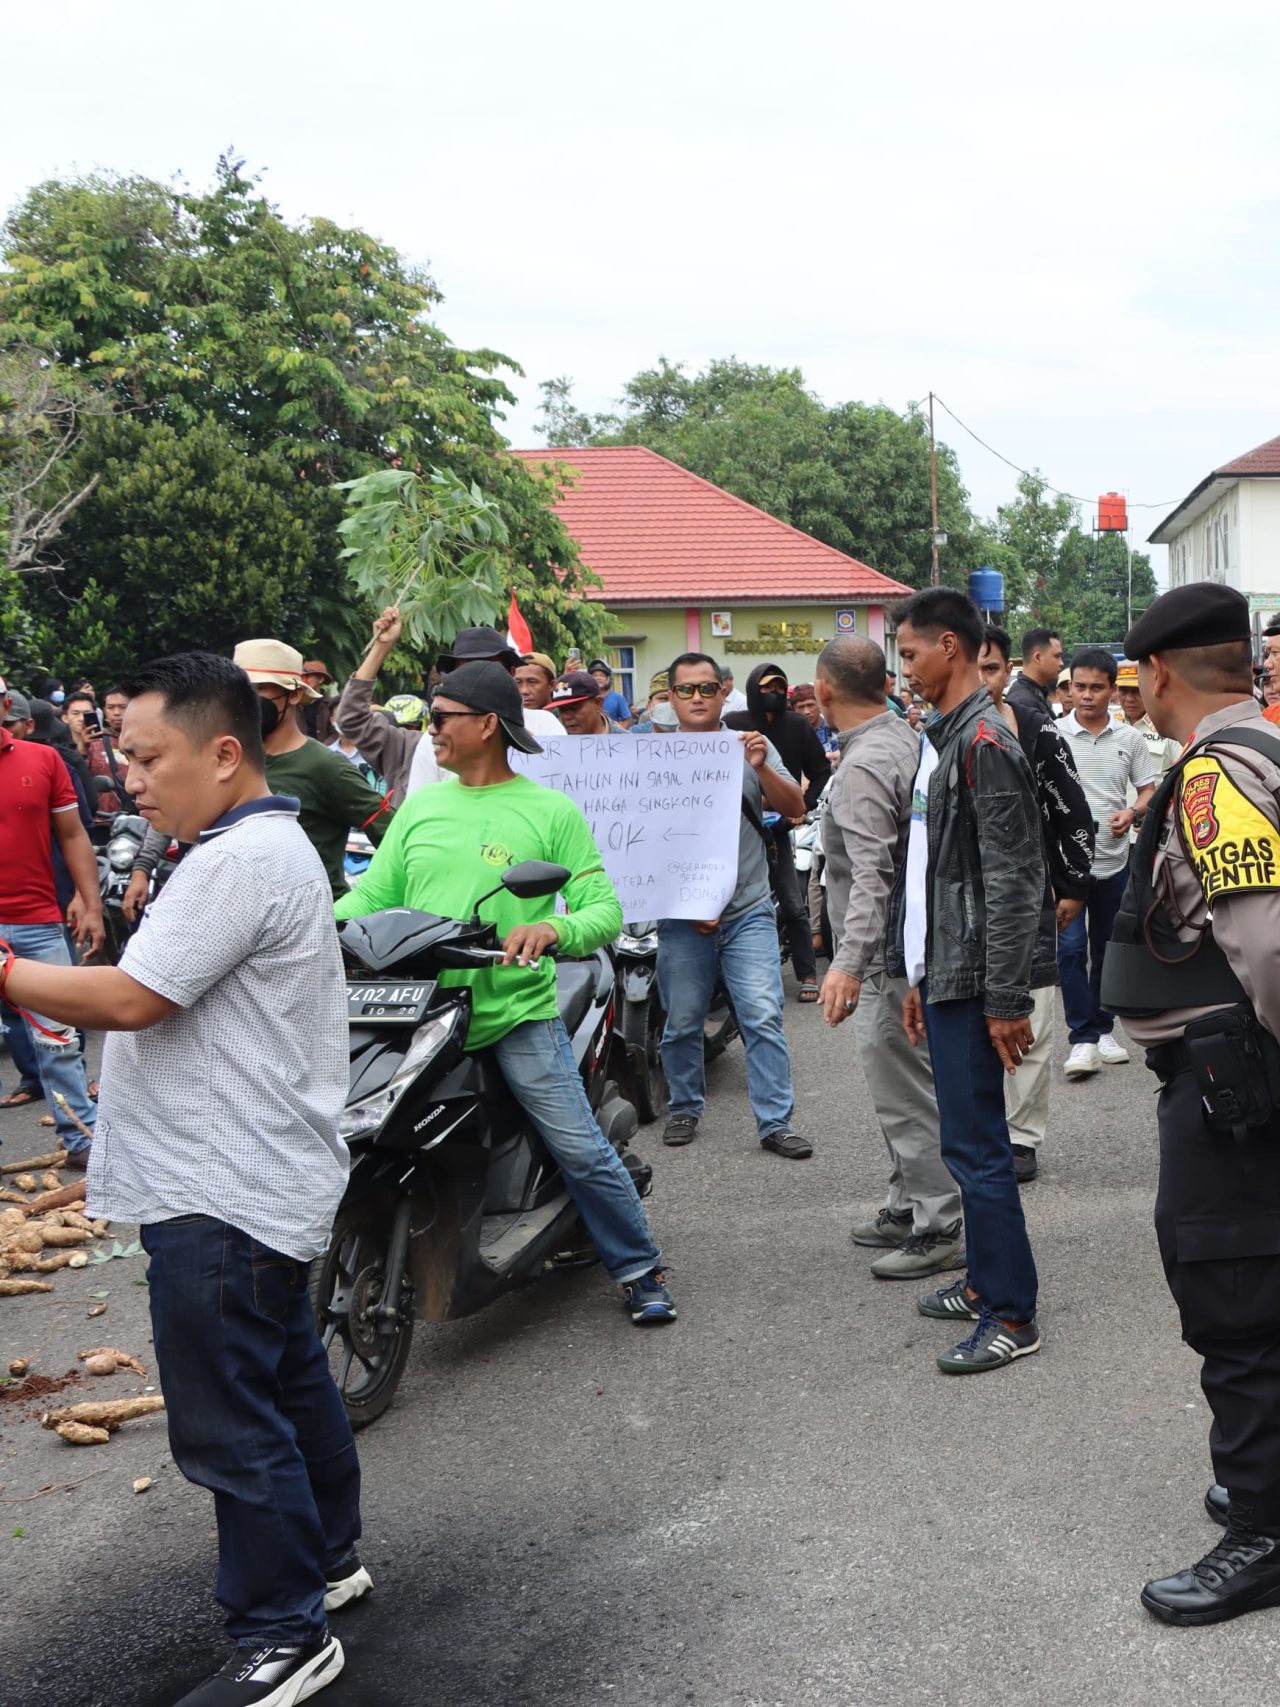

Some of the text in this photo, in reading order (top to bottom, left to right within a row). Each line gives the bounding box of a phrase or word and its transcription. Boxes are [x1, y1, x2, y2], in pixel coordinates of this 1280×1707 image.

[580, 737, 622, 764] PAK
[635, 738, 730, 762] PRABOWO
[540, 772, 612, 792] TAHUN
[619, 770, 639, 790] INI
[691, 769, 730, 783] NIKAH
[584, 795, 714, 815] HARGA SINGKONG
[1193, 837, 1273, 874] ATGAS
[1204, 862, 1276, 897] ENTIF
[388, 987, 425, 1002] AFU
[369, 1007, 385, 1016] 10
[413, 1104, 446, 1133] HONDA
